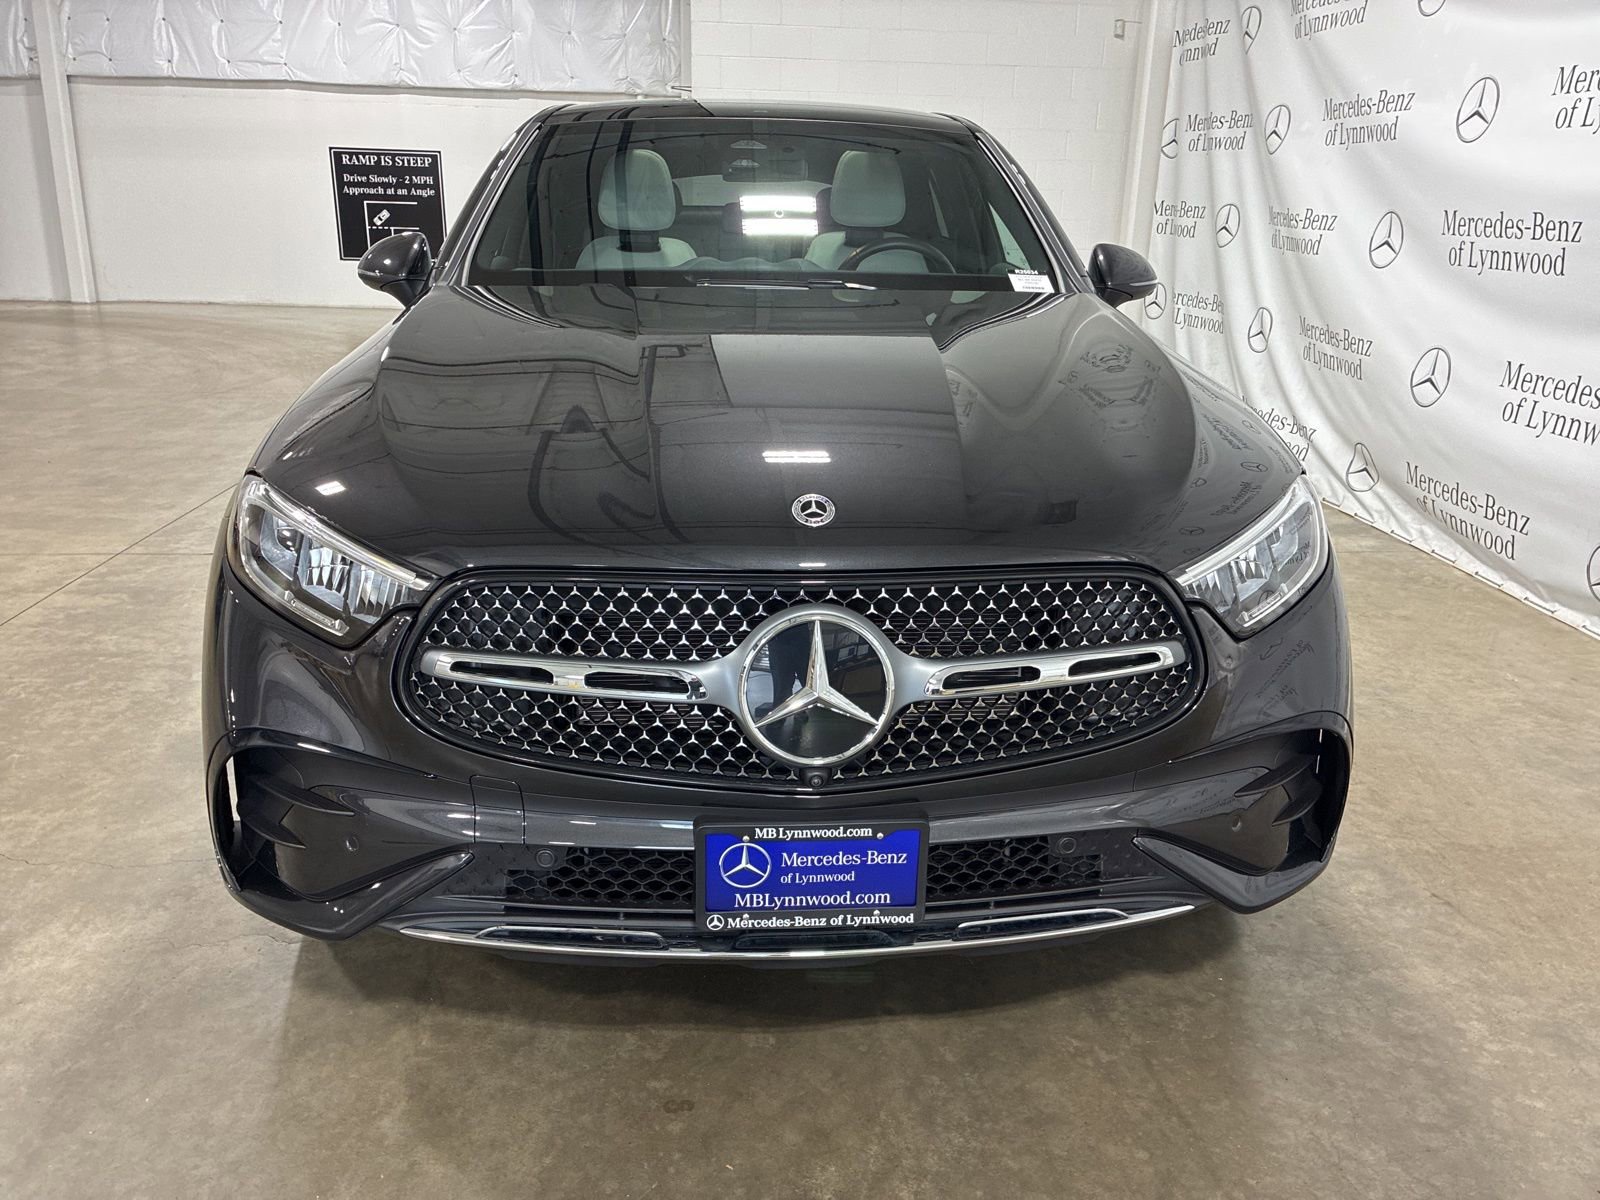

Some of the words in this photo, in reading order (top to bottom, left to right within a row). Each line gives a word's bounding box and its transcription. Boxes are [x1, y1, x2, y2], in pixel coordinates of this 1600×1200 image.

[1294, 15, 1302, 39] of
[1304, 0, 1368, 40] Lynnwood
[1551, 64, 1600, 96] Mer
[1322, 89, 1415, 121] Mercedes-Benz
[1555, 97, 1582, 129] of
[1188, 133, 1200, 152] of
[1325, 122, 1338, 147] of
[1339, 115, 1399, 151] Lynnwood
[341, 154, 378, 165] RAMP
[380, 156, 392, 166] IS
[395, 157, 432, 167] STEEP
[343, 174, 367, 183] Drive
[369, 174, 397, 185] Slowly
[404, 176, 410, 184] 2
[412, 176, 433, 185] MPH
[343, 186, 384, 195] Approach
[386, 187, 395, 195] at
[410, 187, 435, 197] Angle
[1156, 218, 1169, 235] of
[1441, 209, 1584, 243] Mercedes-Benz
[1448, 240, 1465, 267] of
[1467, 241, 1566, 277] Lynnwood
[1299, 315, 1373, 357] Mercedes-Benz
[1303, 341, 1312, 361] of
[1313, 343, 1363, 381] Lynnwood
[1502, 397, 1527, 424] of
[1406, 461, 1530, 536] Mercedes-Benz
[781, 850, 907, 868] Mercedes-Benz
[781, 873, 792, 884] of
[795, 871, 855, 886] Lynnwood
[734, 891, 891, 910] MBLynnwood.com
[727, 916, 827, 929] Mercedes-Benz
[830, 914, 844, 926] of
[846, 913, 914, 927] Lynnwood
